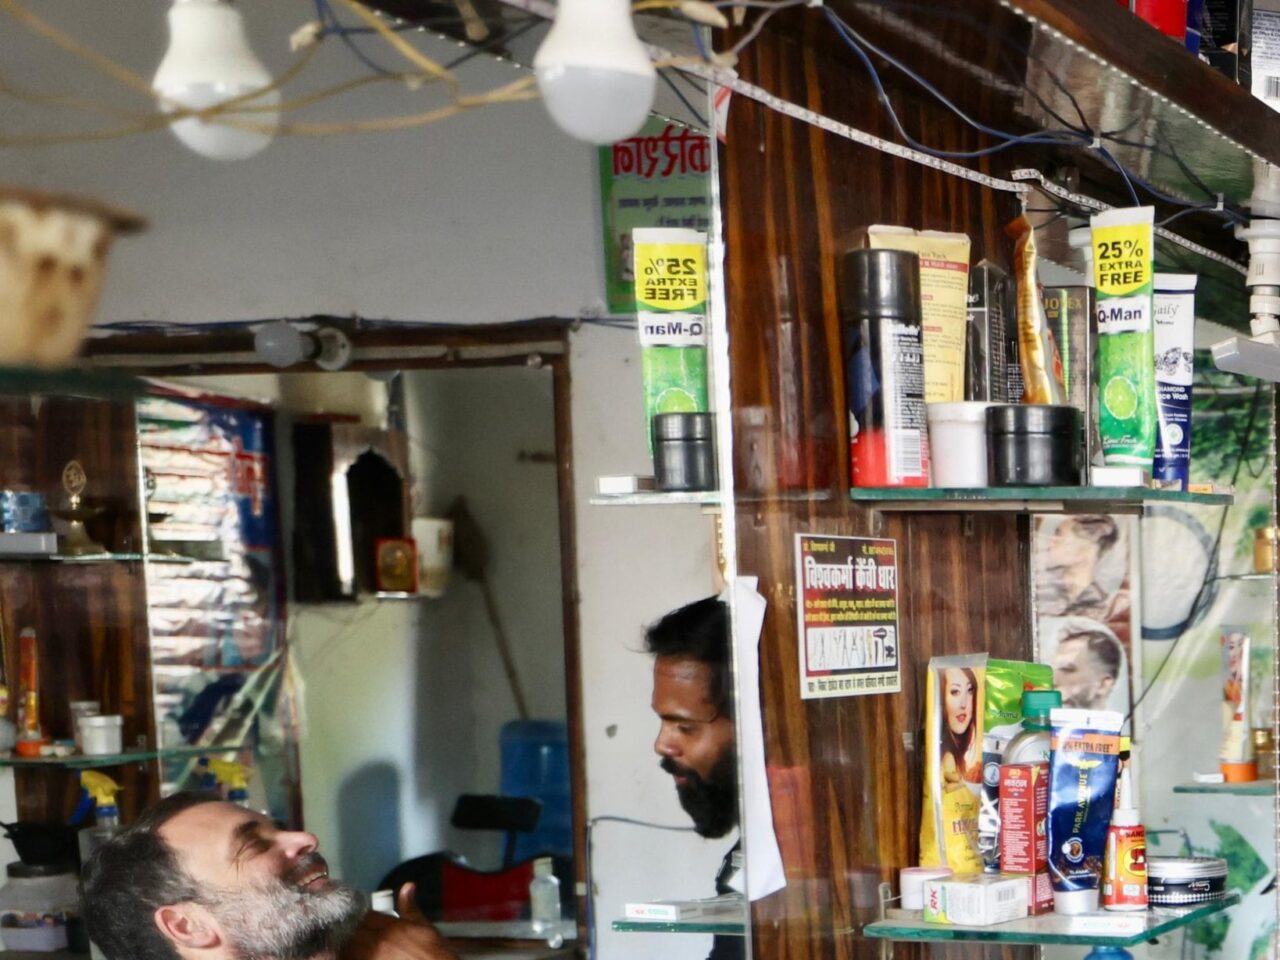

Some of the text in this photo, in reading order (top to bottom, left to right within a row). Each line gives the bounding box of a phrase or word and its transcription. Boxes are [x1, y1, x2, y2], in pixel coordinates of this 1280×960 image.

[1098, 239, 1144, 260] 25%
[1099, 260, 1143, 272] EXTRA
[1099, 270, 1143, 287] FREE
[1043, 297, 1083, 311] JOEX
[1098, 307, 1142, 324] Q-Man
[1172, 392, 1189, 401] Wash
